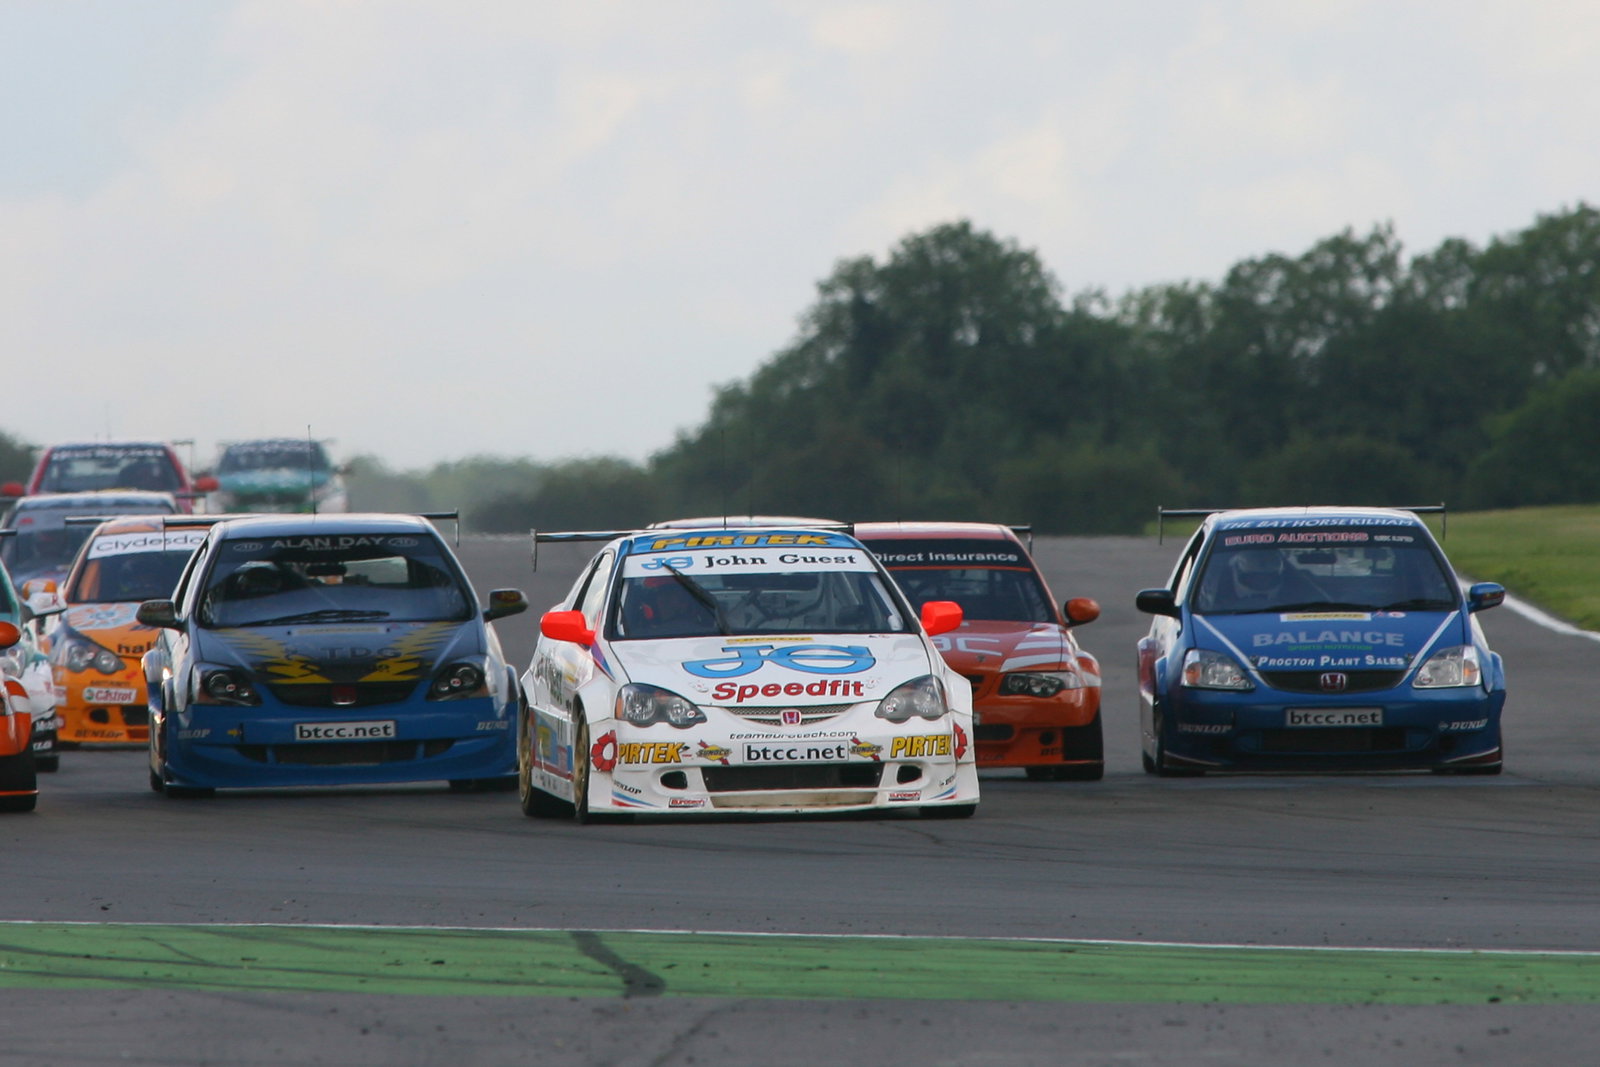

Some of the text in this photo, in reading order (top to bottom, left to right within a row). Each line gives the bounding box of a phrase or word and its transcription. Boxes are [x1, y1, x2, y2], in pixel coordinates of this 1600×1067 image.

[1223, 518, 1414, 530] THE BAY HORSE KILHAM
[271, 537, 331, 549] ALAN
[338, 536, 386, 547] DAY
[652, 535, 830, 550] PIRTEK
[1225, 533, 1274, 546] EURO
[1277, 532, 1369, 543] AUCTIONS
[704, 554, 857, 568] John Guest
[929, 552, 1018, 562] Insurance
[1253, 631, 1405, 647] BALANCE
[95, 689, 133, 701] Castrol
[711, 680, 865, 703] Speedfit
[1290, 710, 1380, 724] btcc.net
[74, 729, 125, 739] DUNLOP
[299, 724, 392, 739] btcc.net
[617, 742, 685, 765] PIRTEK
[746, 745, 846, 762] btcc.net
